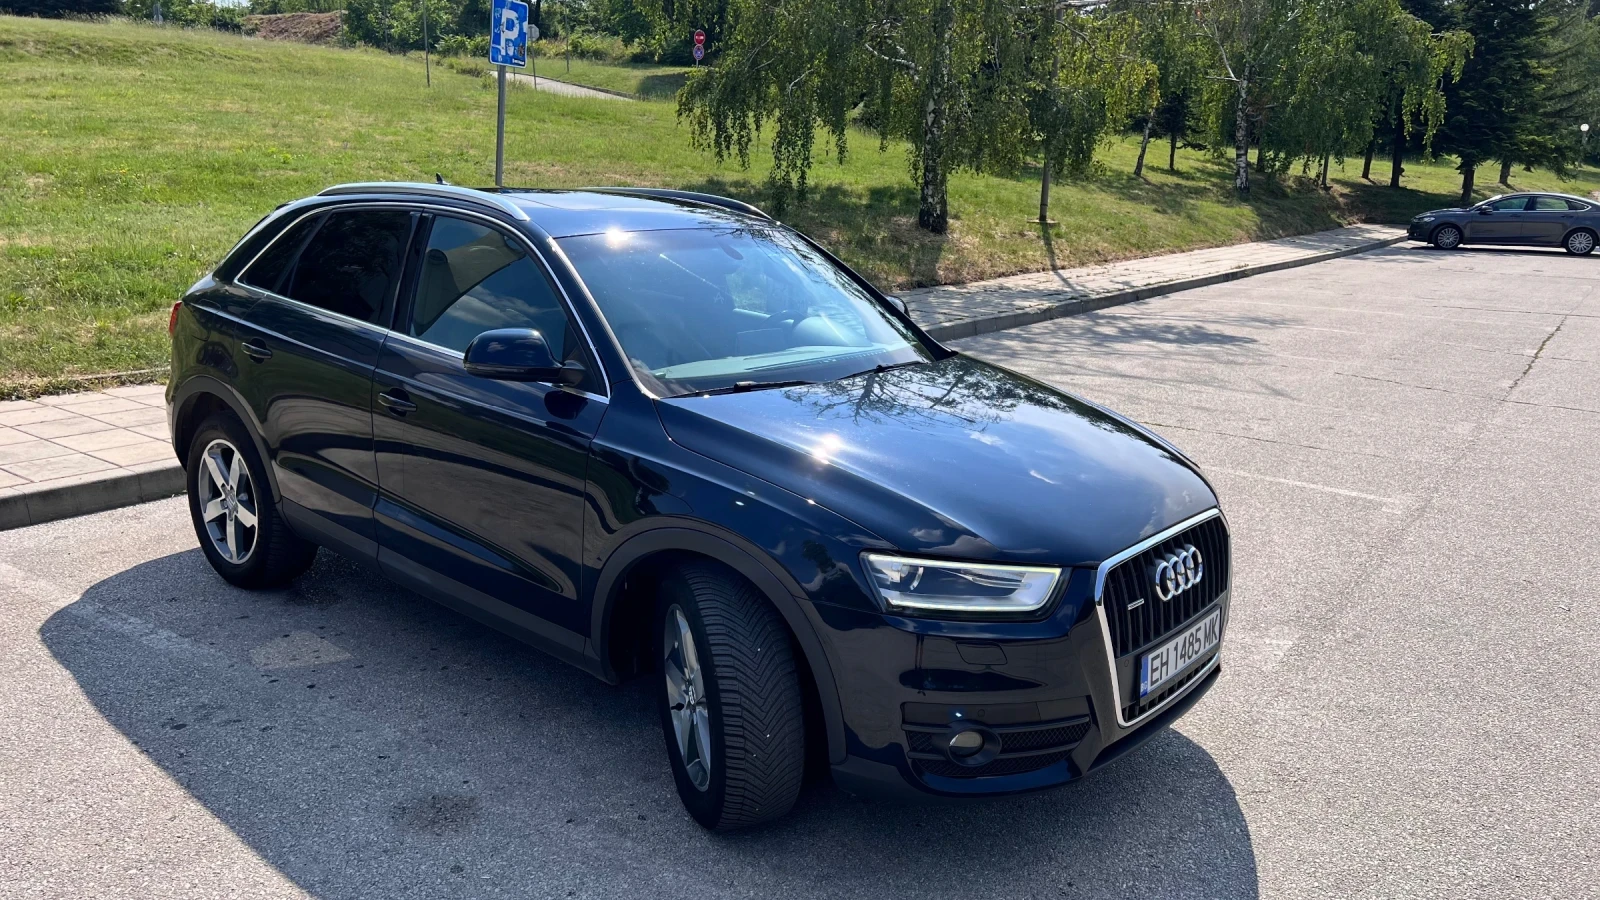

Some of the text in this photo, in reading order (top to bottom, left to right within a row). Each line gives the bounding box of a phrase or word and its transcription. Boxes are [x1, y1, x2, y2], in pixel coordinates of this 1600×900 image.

[501, 9, 519, 56] P
[1150, 613, 1219, 687] EH 1485 MK
